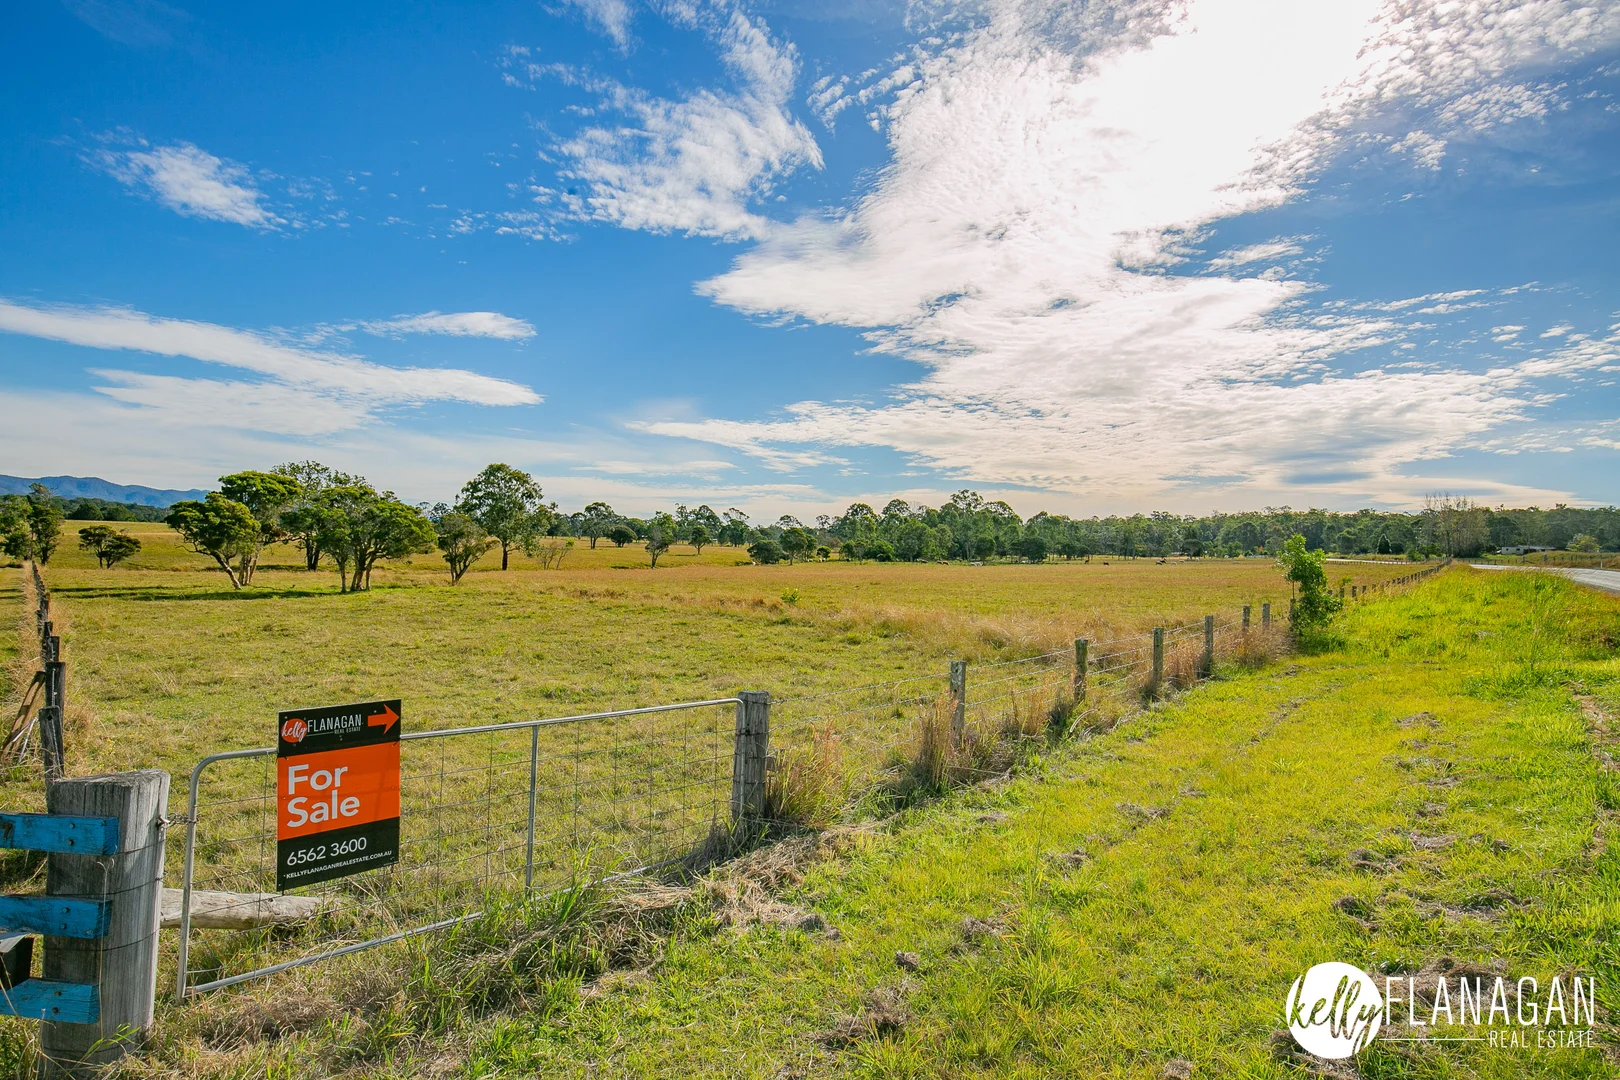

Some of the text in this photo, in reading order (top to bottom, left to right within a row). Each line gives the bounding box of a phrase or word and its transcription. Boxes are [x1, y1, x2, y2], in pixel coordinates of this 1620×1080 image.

[307, 713, 362, 733] FLANAGAN
[346, 726, 361, 734] ESTATE
[288, 764, 348, 795] For
[286, 789, 360, 828] Sale
[286, 850, 392, 879] KELLYFLANAGANREALESTATE.COM.AU
[287, 837, 367, 866] 6562 3600
